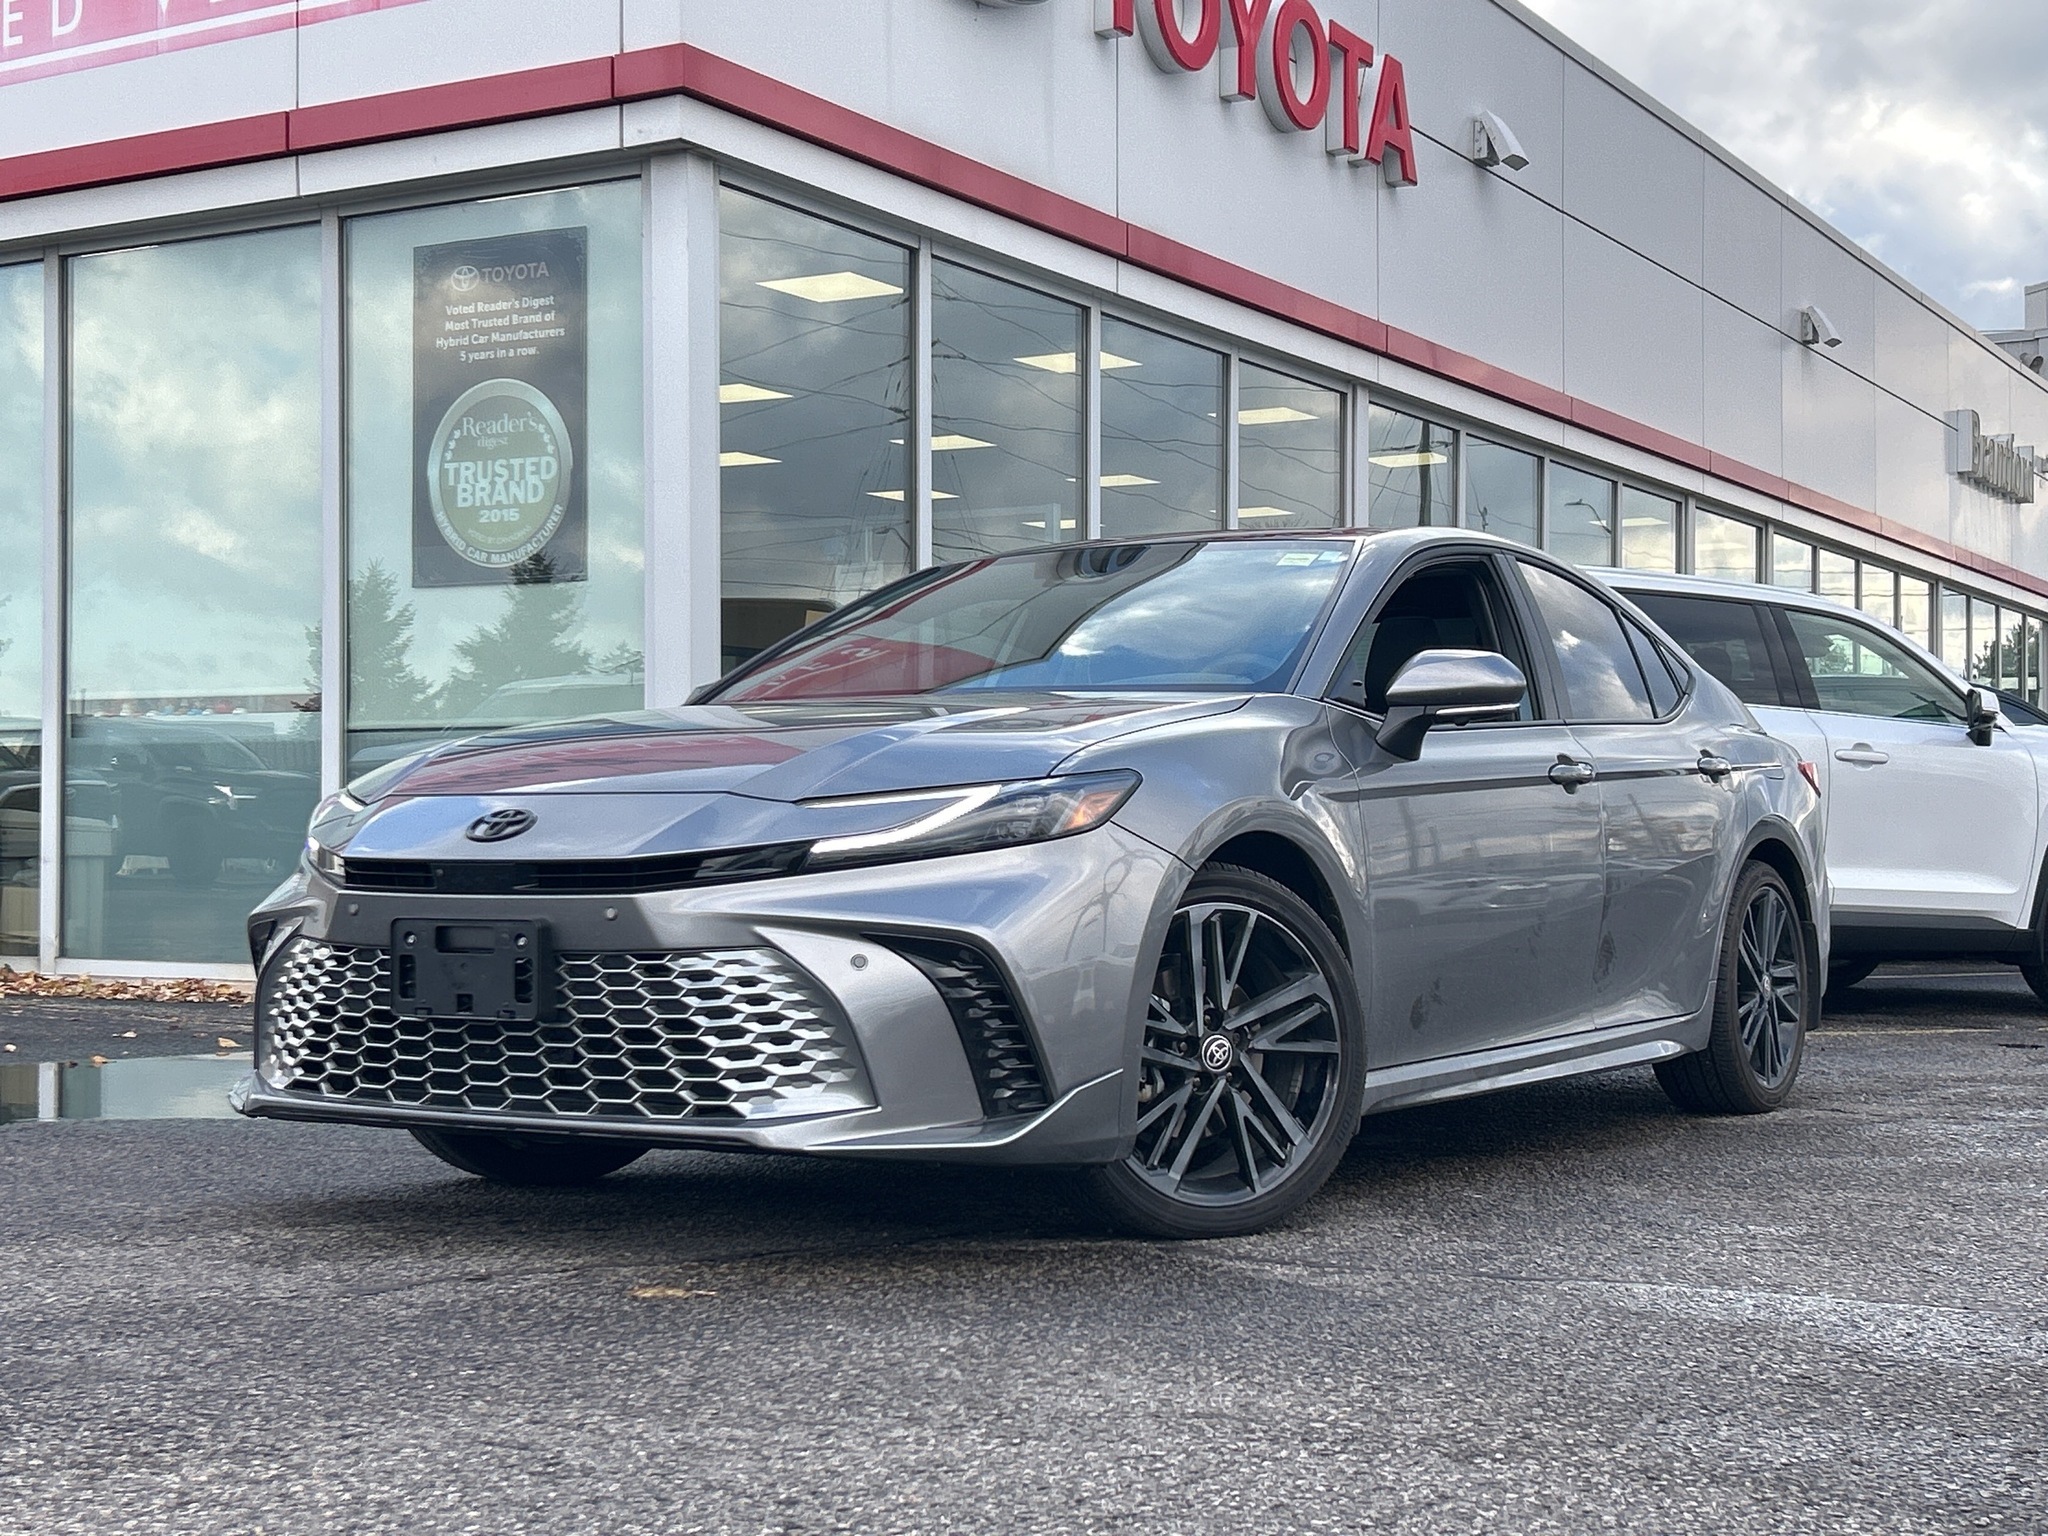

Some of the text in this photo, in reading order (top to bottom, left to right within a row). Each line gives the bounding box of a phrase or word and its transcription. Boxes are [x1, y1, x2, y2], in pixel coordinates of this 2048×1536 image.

[481, 261, 549, 284] TOYOTA
[445, 295, 555, 316] Voted Reader's Digest
[445, 310, 555, 331] Most Trusted Brand of
[436, 327, 565, 350] Hybrid Car Manufacturers
[460, 346, 540, 363] 5 years in a row.
[461, 411, 538, 437] Reader's
[477, 435, 508, 450] digest
[444, 456, 558, 486] TRUSTED
[457, 476, 545, 507] BRAND
[479, 508, 520, 523] 2015
[436, 511, 466, 551] HYBRID
[467, 546, 488, 562] CAR
[491, 504, 563, 563] MANUFACTURER
